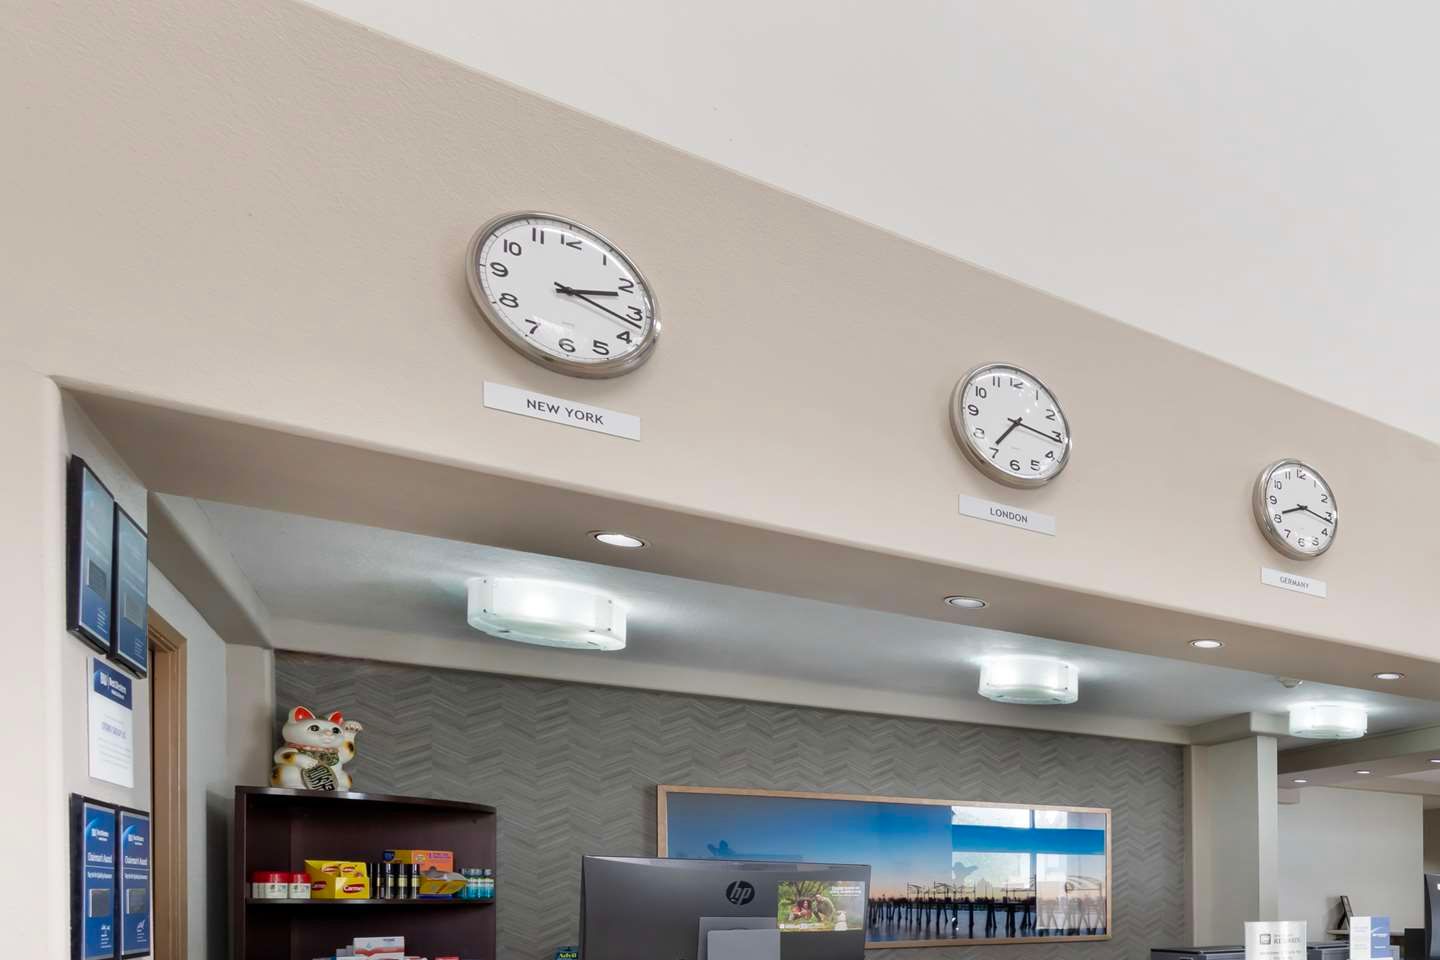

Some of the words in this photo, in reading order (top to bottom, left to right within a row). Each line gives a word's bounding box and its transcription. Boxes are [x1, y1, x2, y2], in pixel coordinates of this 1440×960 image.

[532, 227, 545, 244] 11
[560, 233, 583, 251] 12
[503, 239, 522, 256] 10
[602, 254, 607, 266] 1
[490, 261, 509, 278] 9
[618, 277, 635, 294] 2
[499, 292, 519, 309] 8
[626, 306, 643, 322] 3
[524, 318, 541, 335] 7
[616, 330, 633, 344] 4
[559, 337, 576, 353] 6
[592, 339, 610, 356] 5
[992, 376, 1001, 388] 11
[1009, 377, 1025, 389] 12
[975, 386, 987, 399] 10
[1035, 390, 1039, 401] 1
[526, 398, 560, 415] NEW
[564, 406, 604, 425] YORK
[967, 404, 979, 417] 9
[1045, 409, 1056, 421] 2
[1051, 430, 1062, 442] 3
[989, 447, 999, 460] 7
[1045, 450, 1056, 461] 4
[1009, 459, 1021, 472] 6
[1030, 459, 1042, 472] 5
[1285, 471, 1291, 481] 11
[1296, 468, 1307, 480] 12
[1274, 480, 1282, 490] 10
[1269, 495, 1278, 505] 9
[1320, 494, 1329, 503] 2
[989, 506, 1029, 524] LONDON
[1274, 514, 1282, 524] 8
[1284, 529, 1292, 538] 7
[1321, 527, 1329, 537] 4
[1298, 537, 1306, 547] 6
[729, 880, 753, 905] hp
